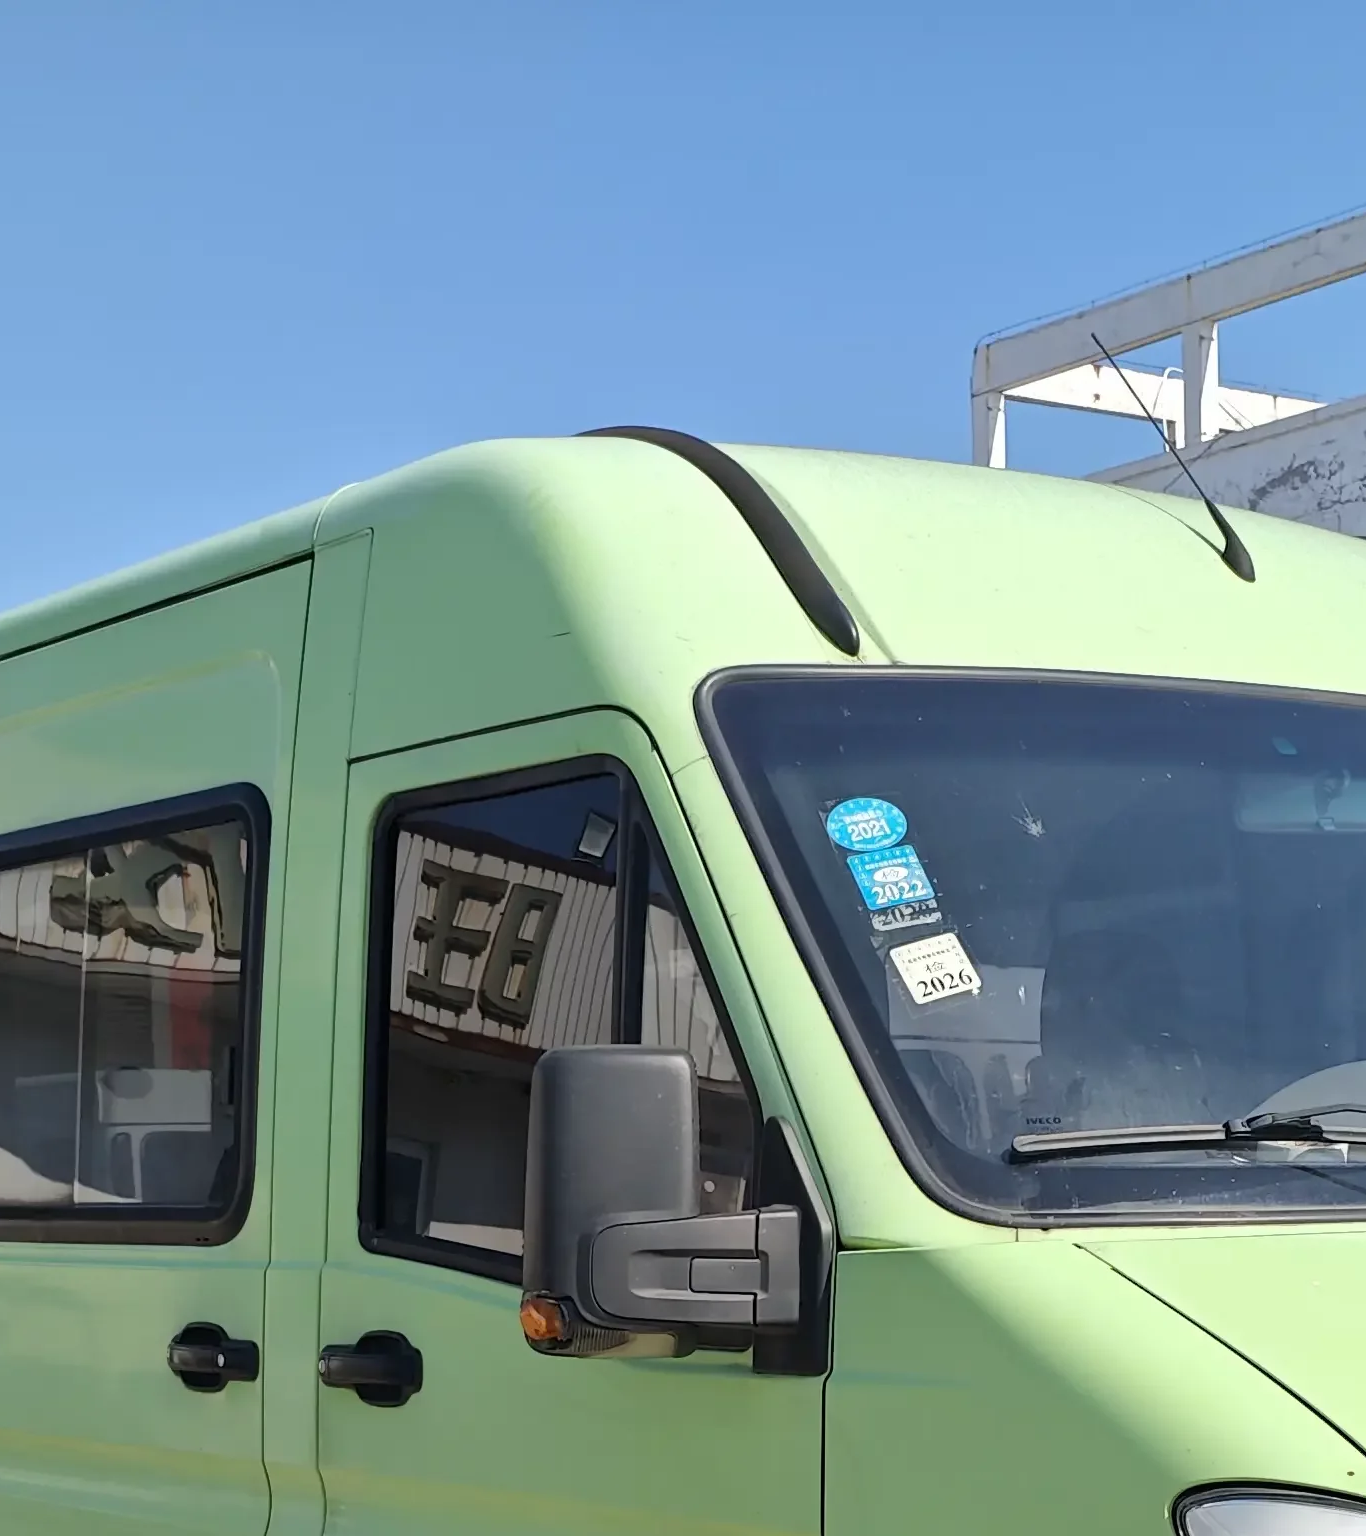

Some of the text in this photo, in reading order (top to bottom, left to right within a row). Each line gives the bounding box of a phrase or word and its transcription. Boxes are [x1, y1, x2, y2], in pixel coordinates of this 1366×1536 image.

[848, 819, 892, 842] 2021
[871, 879, 927, 905] 2022
[916, 969, 973, 998] 2026
[1025, 1116, 1062, 1125] IVECO
